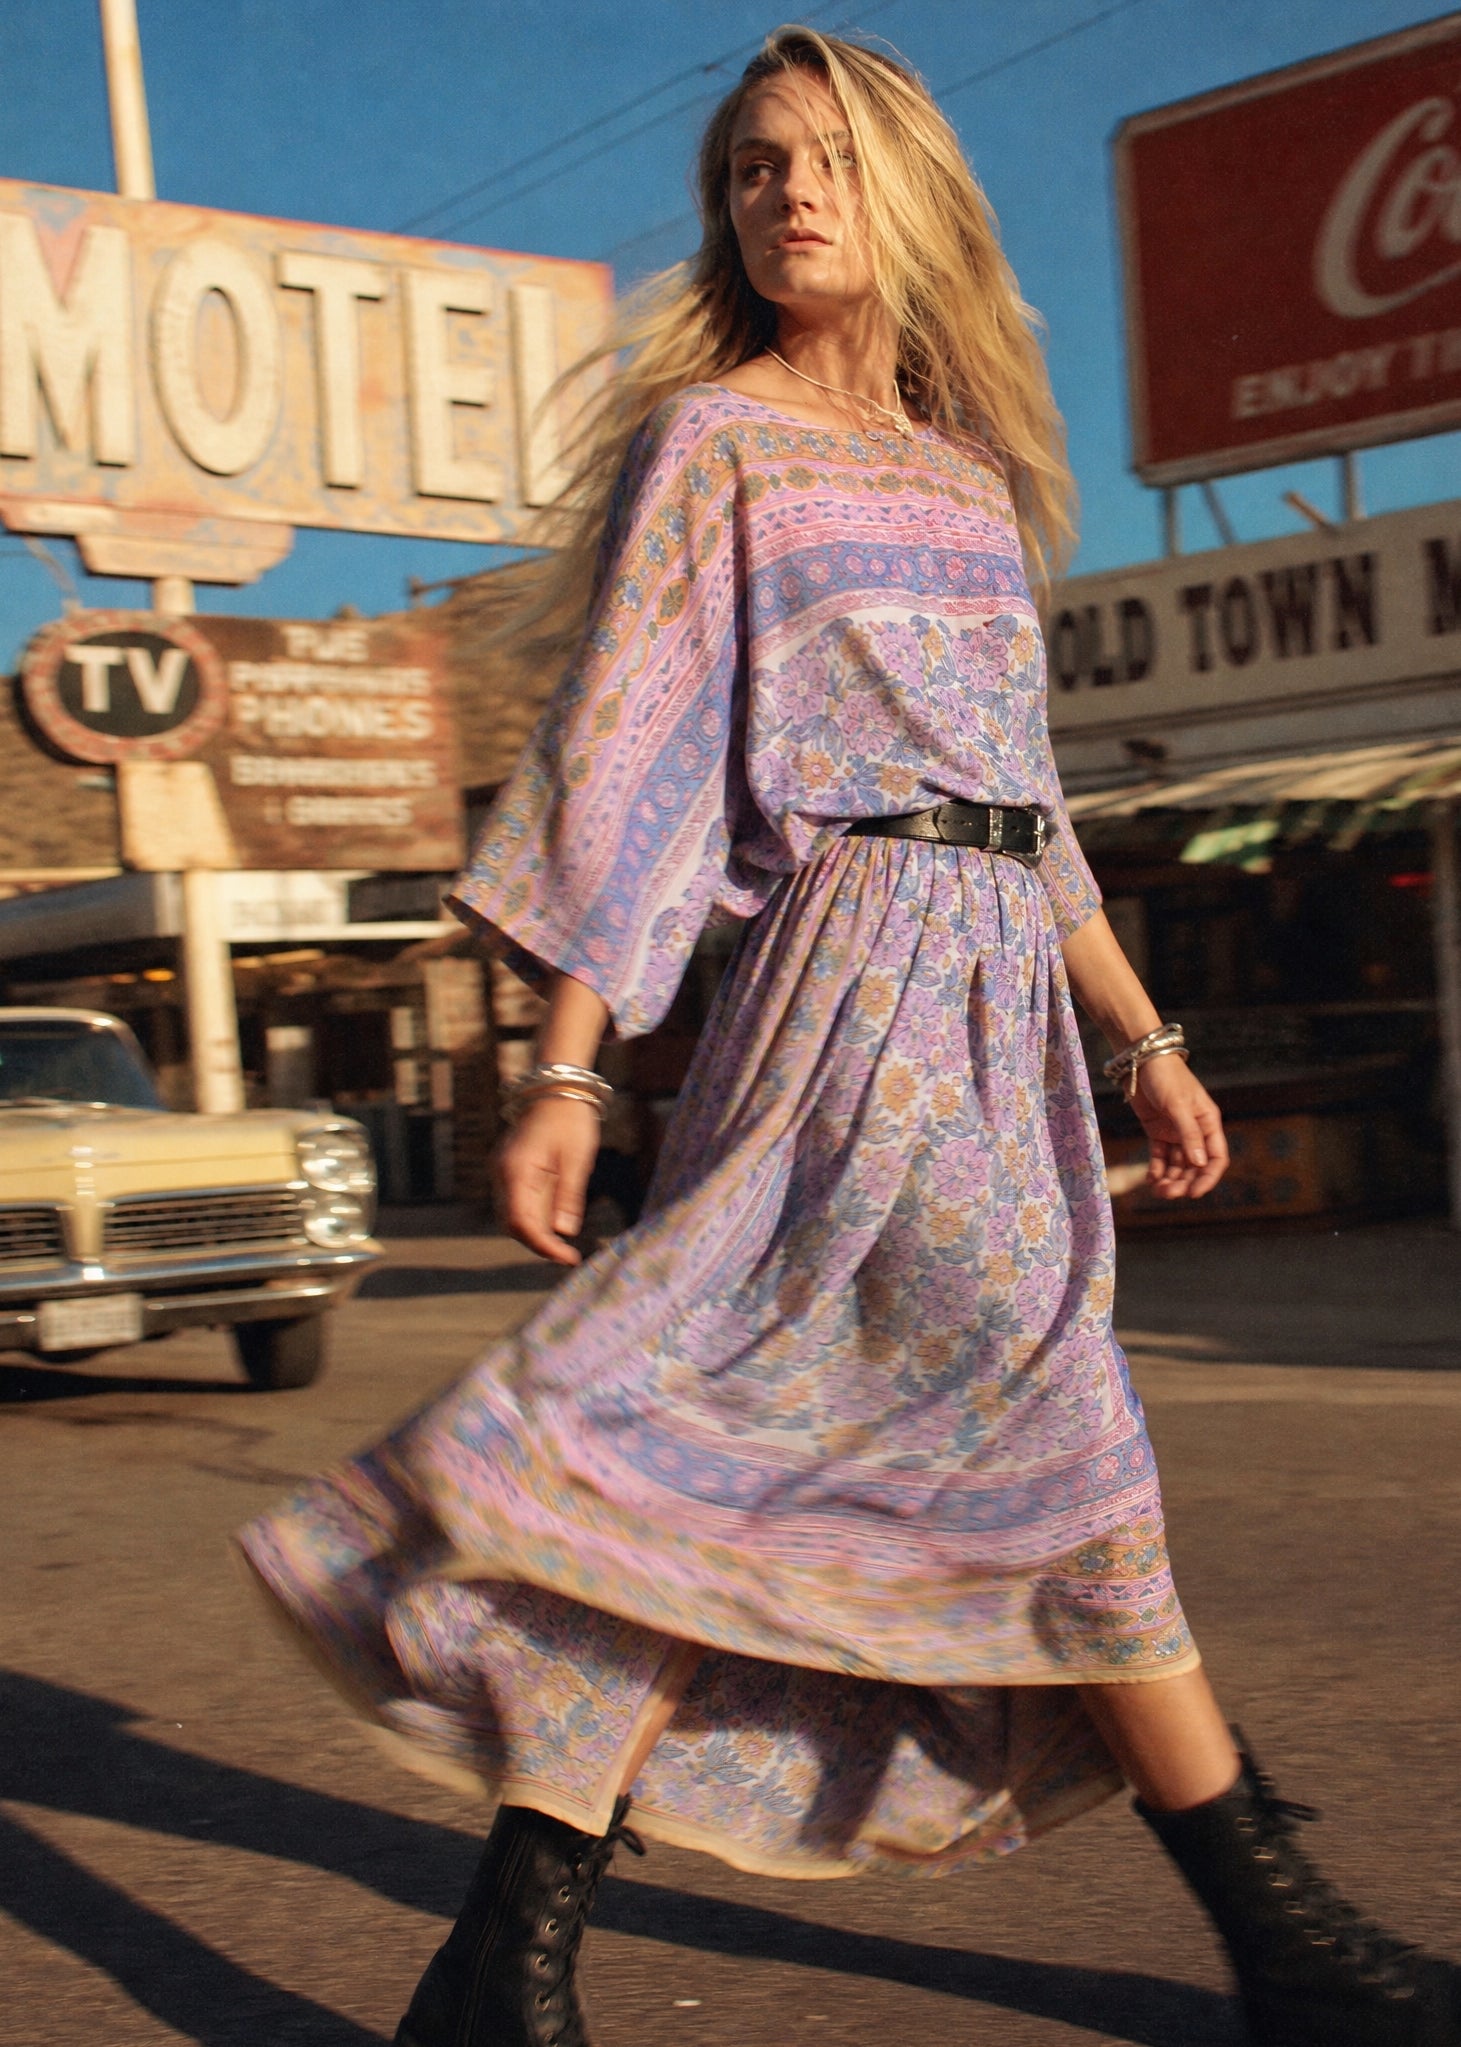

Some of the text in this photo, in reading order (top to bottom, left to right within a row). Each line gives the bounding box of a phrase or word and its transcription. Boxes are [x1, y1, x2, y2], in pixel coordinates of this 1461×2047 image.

[0, 212, 582, 507] MOTEL
[1229, 343, 1396, 419] ENJOY
[1051, 597, 1156, 691] OLD
[1179, 551, 1379, 674] TOWN
[64, 645, 189, 713] TV
